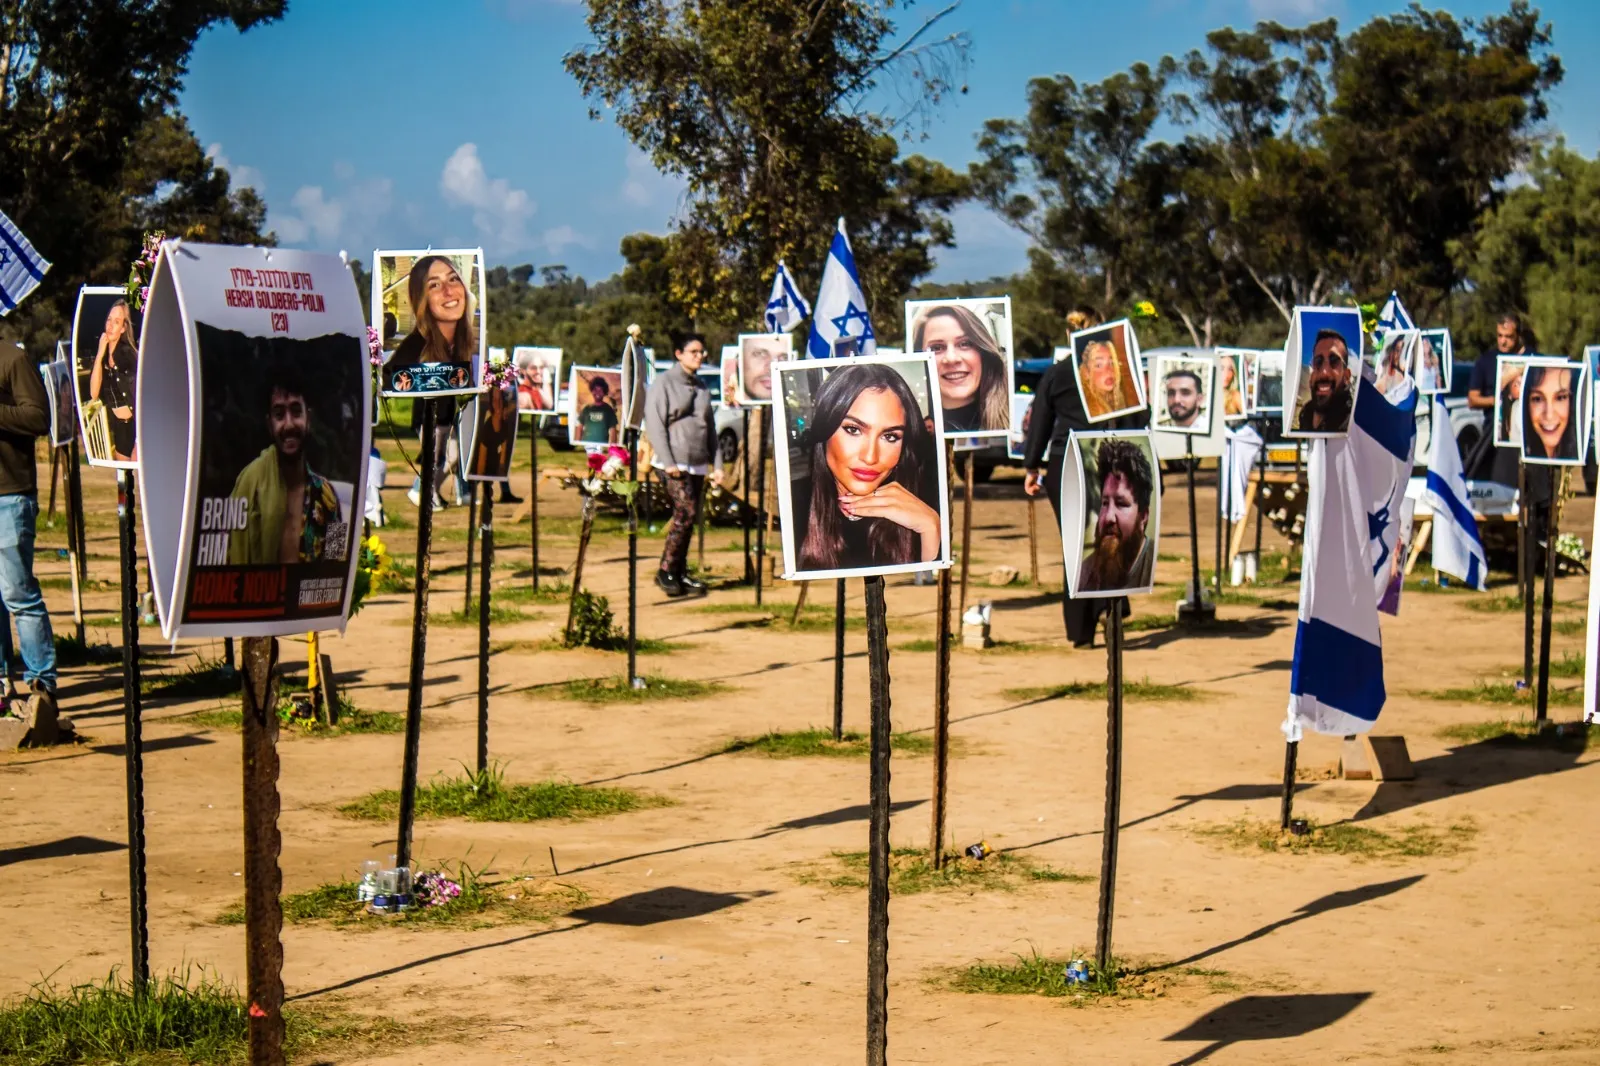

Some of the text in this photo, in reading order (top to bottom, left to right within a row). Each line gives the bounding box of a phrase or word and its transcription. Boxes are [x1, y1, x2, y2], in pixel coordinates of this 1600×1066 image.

[290, 272, 313, 290] הירש
[225, 289, 325, 312] HERSH GOLDBERG-POLIN
[270, 312, 288, 333] (23)
[201, 497, 248, 530] BRING
[196, 532, 230, 566] HIM
[192, 567, 287, 604] HOME NOW!
[299, 588, 342, 605] FAMILIES FORUM
